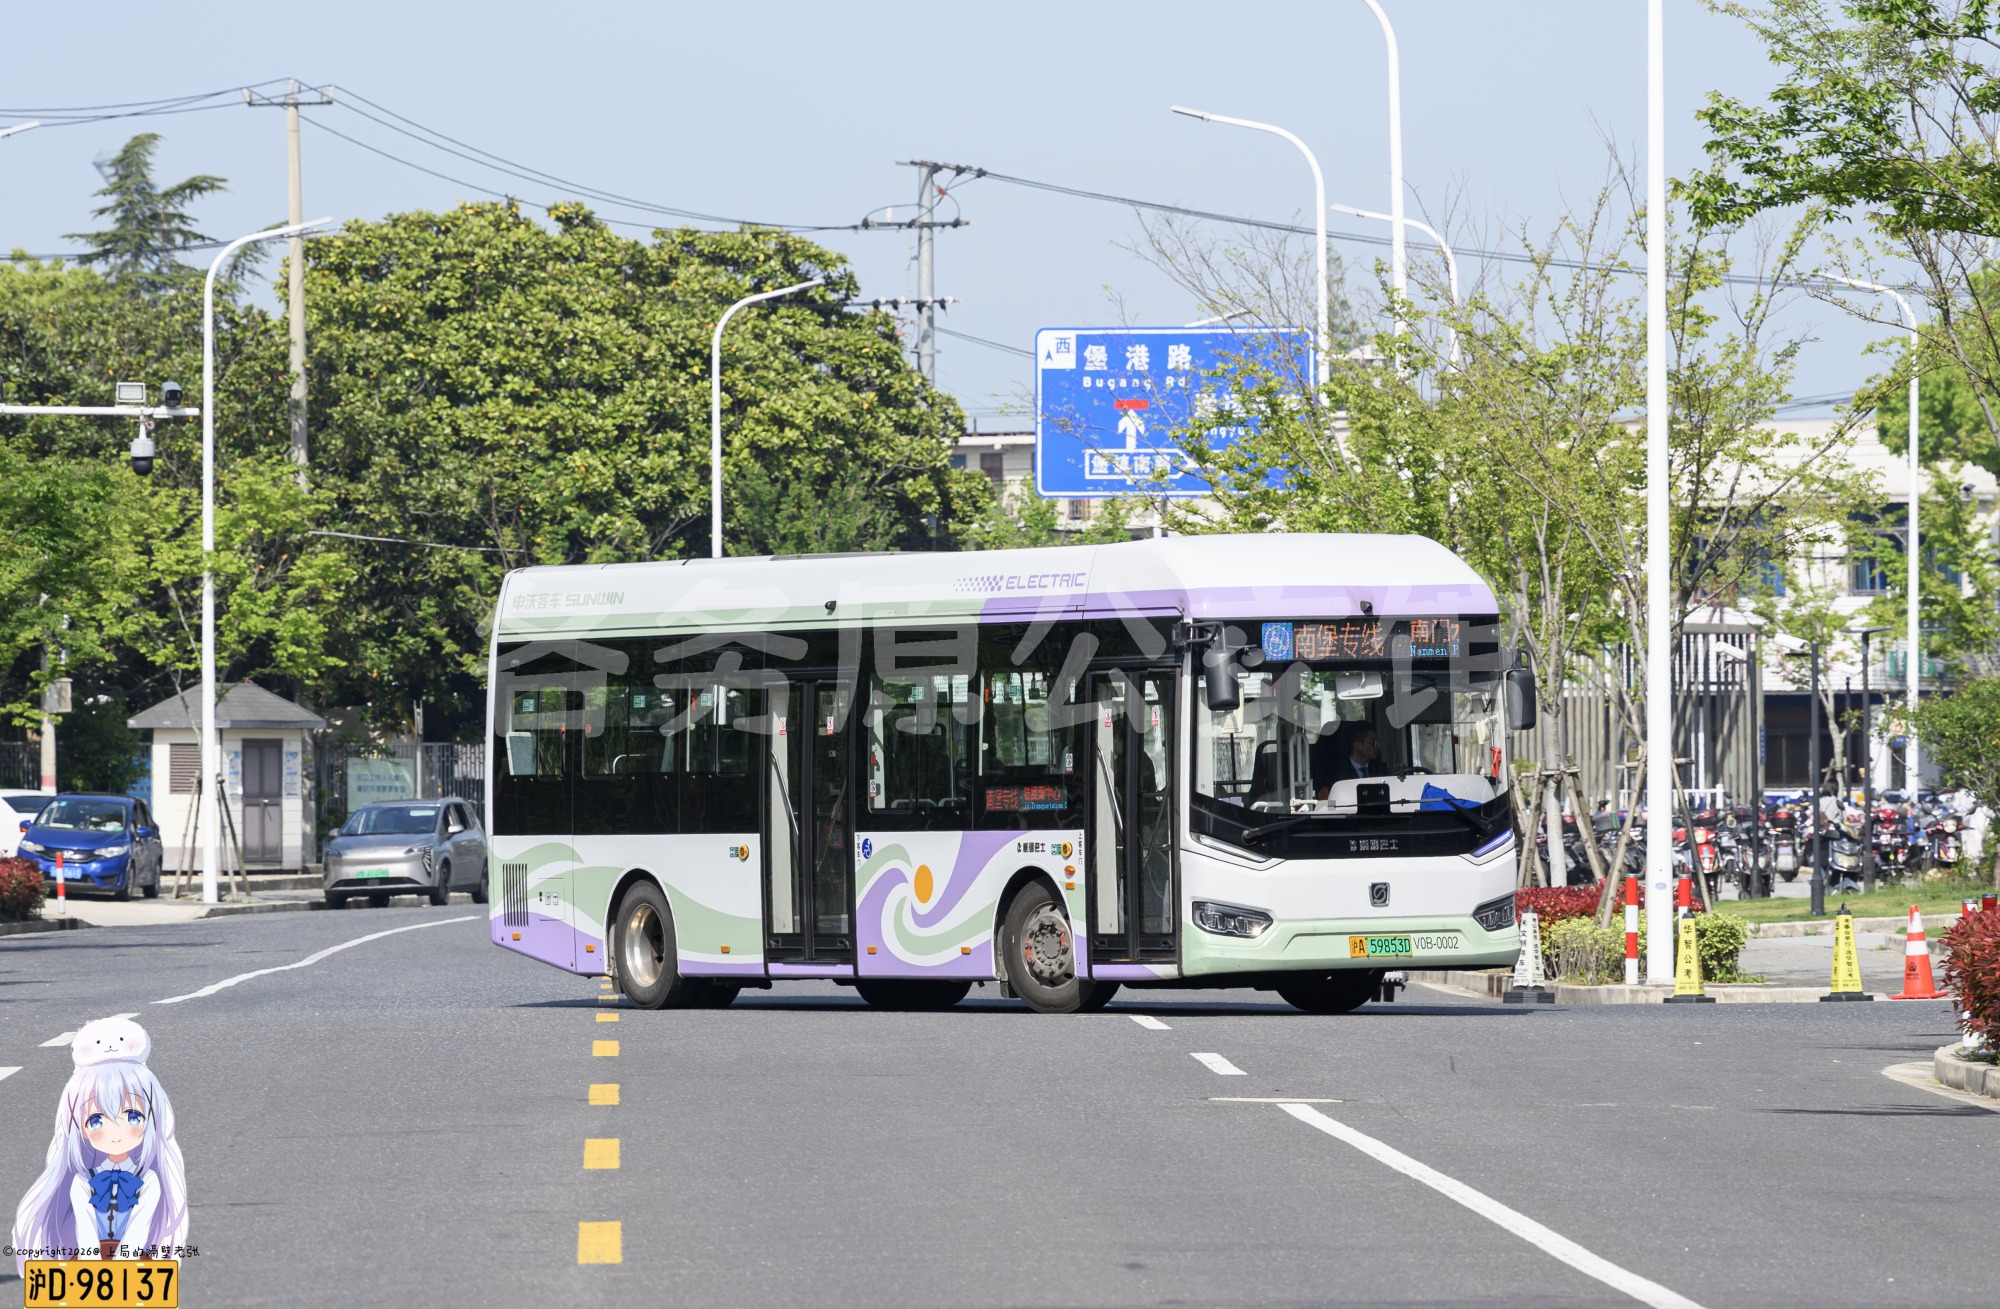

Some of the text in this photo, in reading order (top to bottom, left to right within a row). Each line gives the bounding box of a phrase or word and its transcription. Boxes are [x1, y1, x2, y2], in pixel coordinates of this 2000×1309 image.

[1055, 337, 1071, 354] 西
[1083, 344, 1192, 371] 堡港路
[1083, 375, 1187, 389] Bugang Rd
[1006, 572, 1086, 590] ELECTRIC
[513, 591, 625, 610] 申沃客车 SUNWIN
[1294, 622, 1384, 659] 南堡专线
[1410, 645, 1447, 657] Nanmen
[986, 788, 1019, 810] 南堡专线
[1684, 924, 1693, 979] 华智公考
